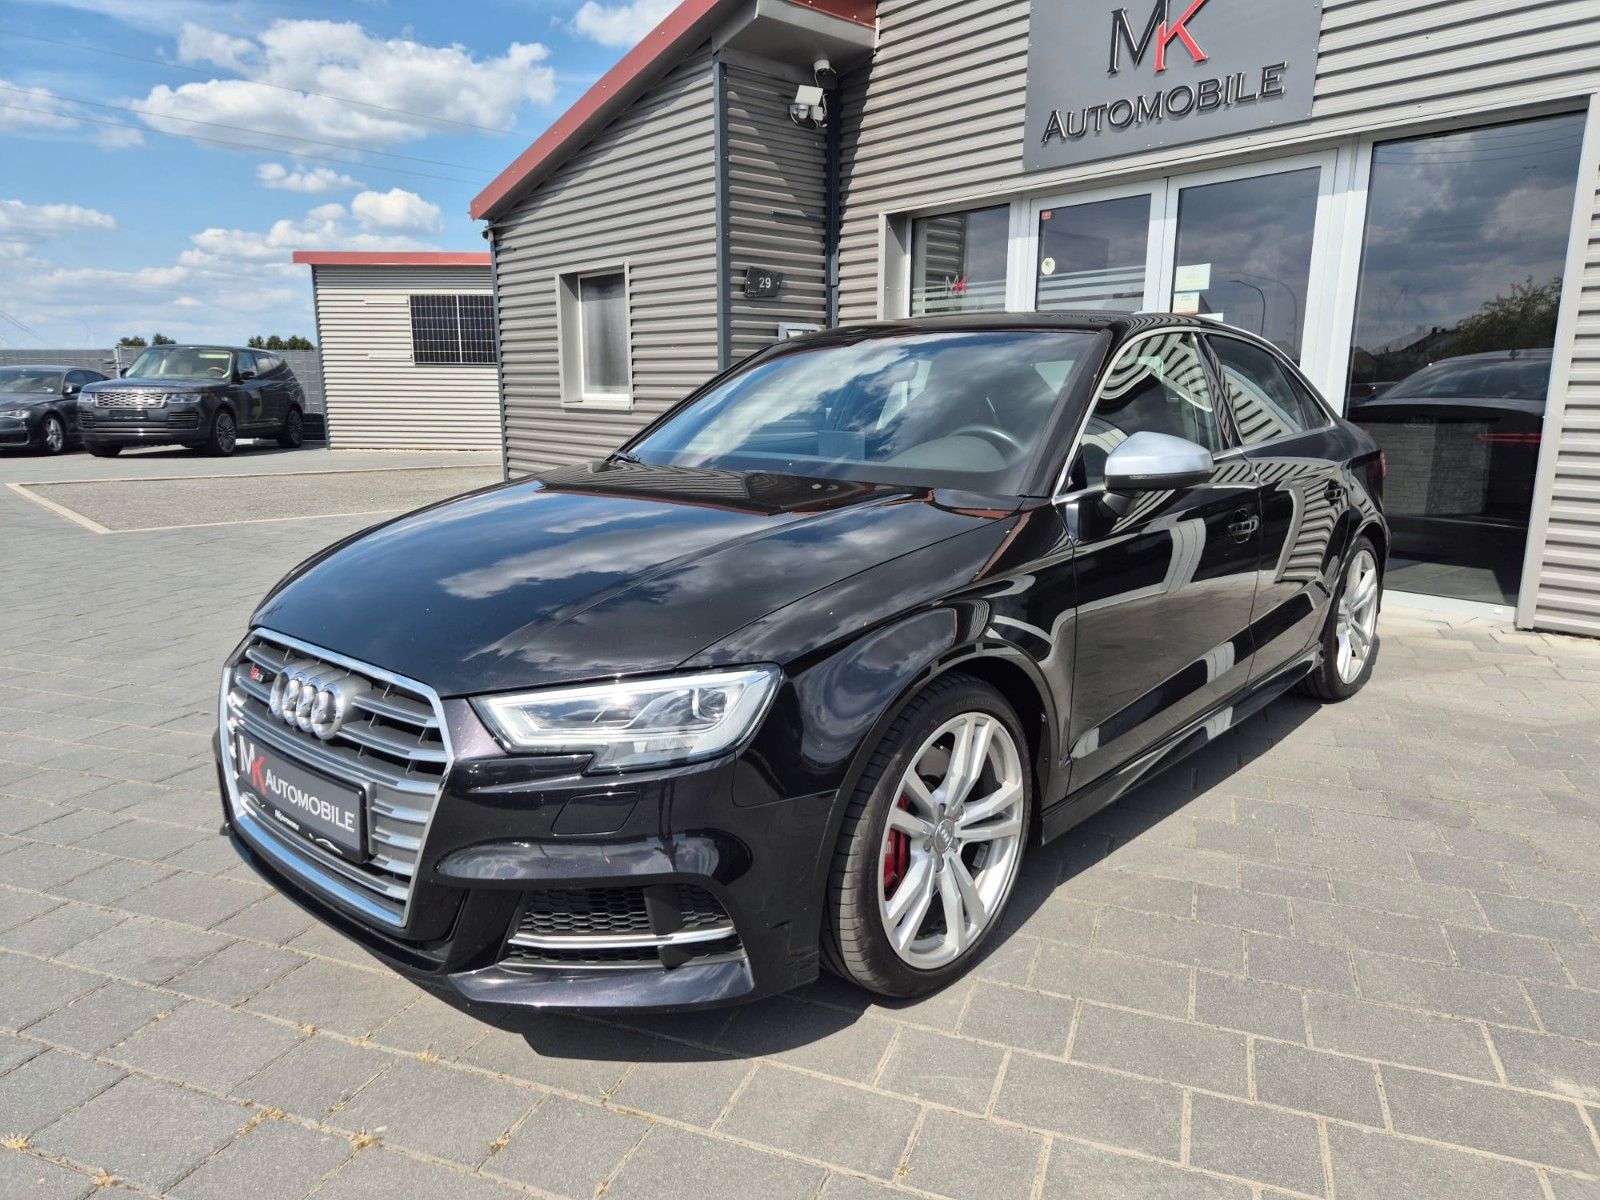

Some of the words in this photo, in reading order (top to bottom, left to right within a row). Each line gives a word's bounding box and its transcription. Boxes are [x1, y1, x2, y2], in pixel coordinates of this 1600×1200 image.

[1107, 0, 1208, 73] MK
[1041, 61, 1288, 143] AUTOMOBILE
[759, 277, 771, 288] 29
[239, 735, 268, 796] MK
[265, 769, 355, 833] AUTOMOBILE
